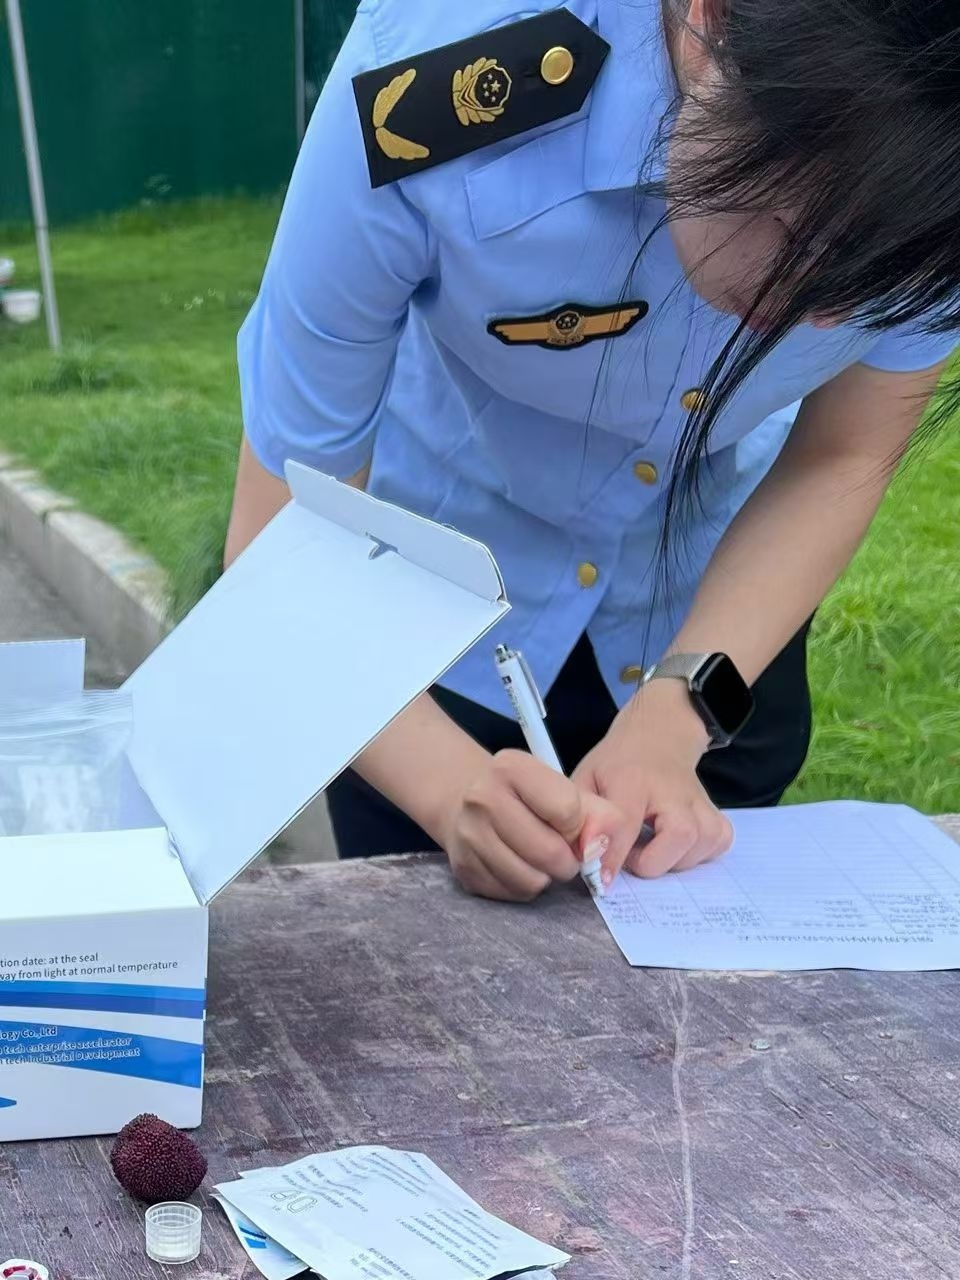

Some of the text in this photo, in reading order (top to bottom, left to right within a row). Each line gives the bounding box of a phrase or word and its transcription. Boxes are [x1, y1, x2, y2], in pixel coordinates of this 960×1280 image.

[22, 956, 47, 967] date:
[48, 955, 59, 965] at
[61, 953, 78, 964] the
[79, 951, 99, 963] seal
[18, 969, 42, 980] from
[43, 967, 67, 979] light
[68, 966, 79, 977] at
[80, 964, 116, 976] normal
[117, 960, 178, 974] temperature
[4, 1043, 25, 1054] tech
[5, 1055, 26, 1066] tech
